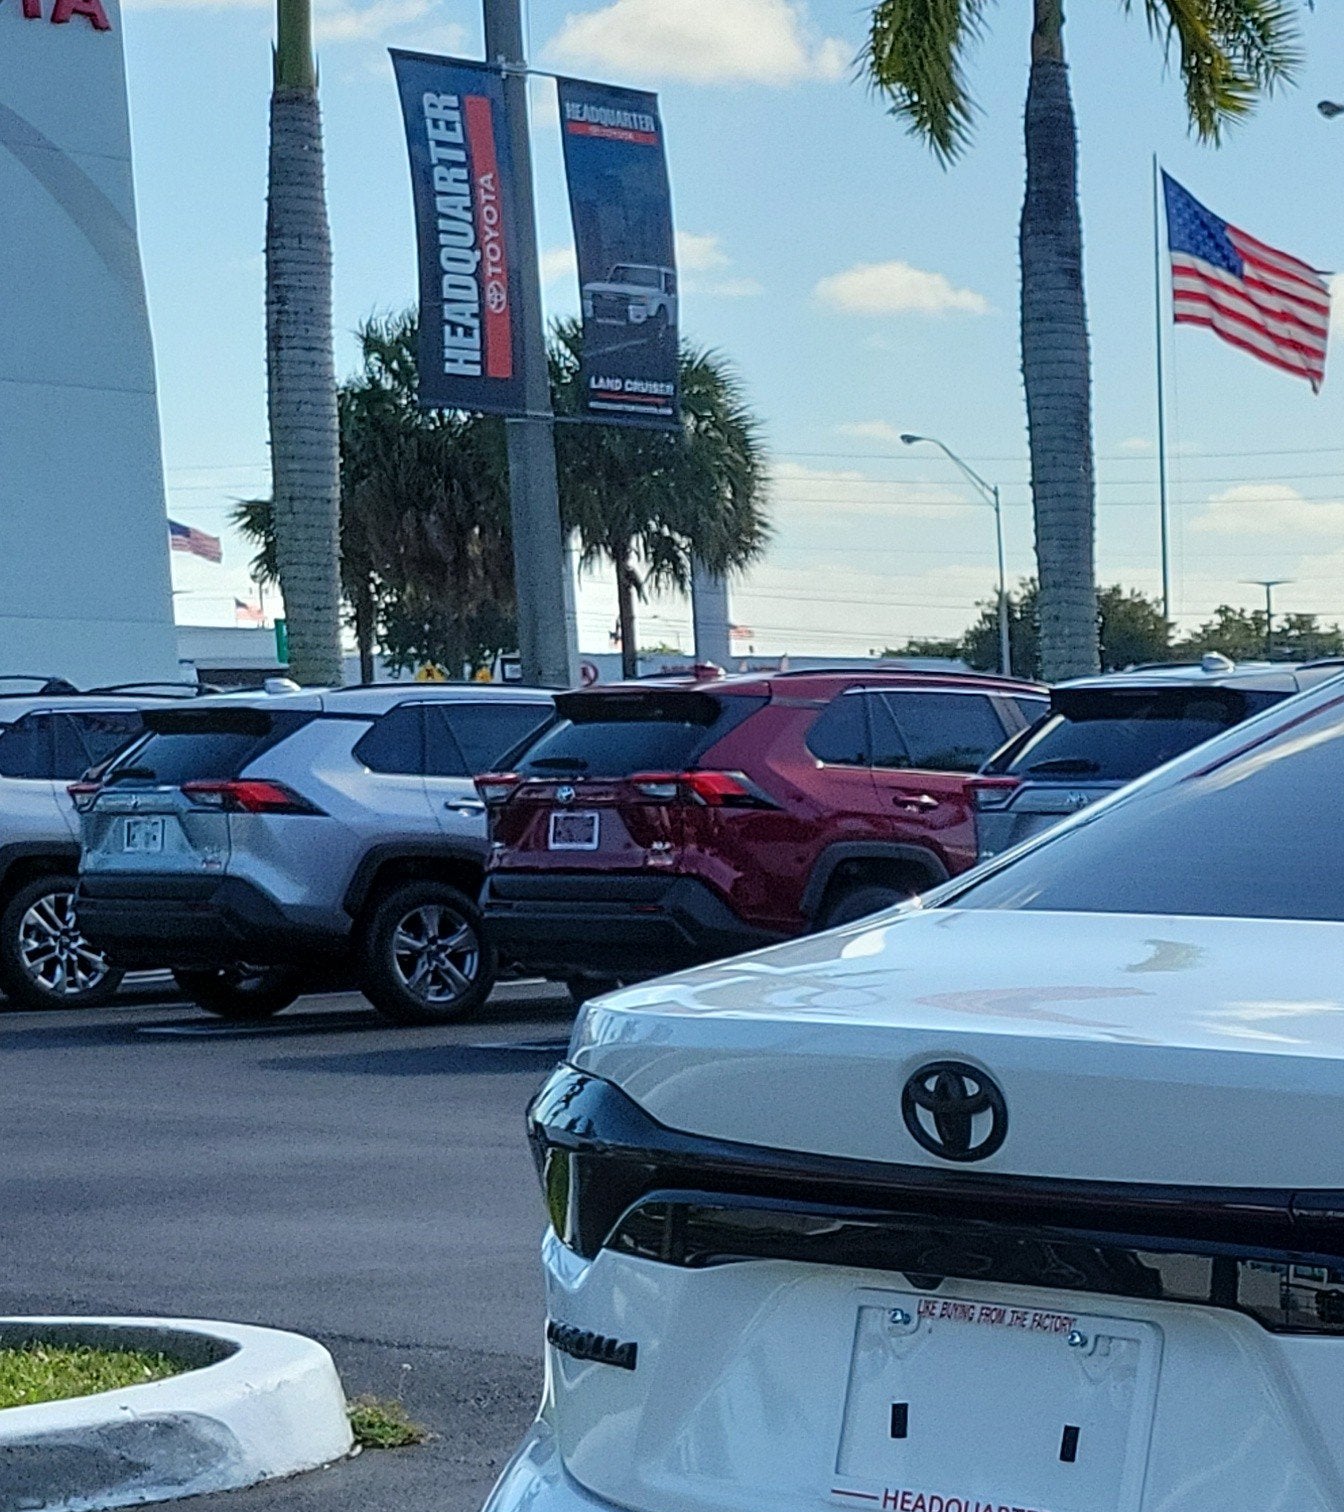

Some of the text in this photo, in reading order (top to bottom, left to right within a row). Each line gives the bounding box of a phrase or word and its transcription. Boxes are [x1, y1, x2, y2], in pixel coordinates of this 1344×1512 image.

[565, 102, 655, 133] HEADQUARTER
[423, 92, 482, 377] HEADQUARTER
[479, 173, 503, 276] TOYOTA
[590, 375, 623, 392] LAND
[917, 1300, 938, 1317] LIKE
[939, 1301, 975, 1322] BUYING
[977, 1305, 1007, 1325] FROM
[1007, 1309, 1030, 1329] THE
